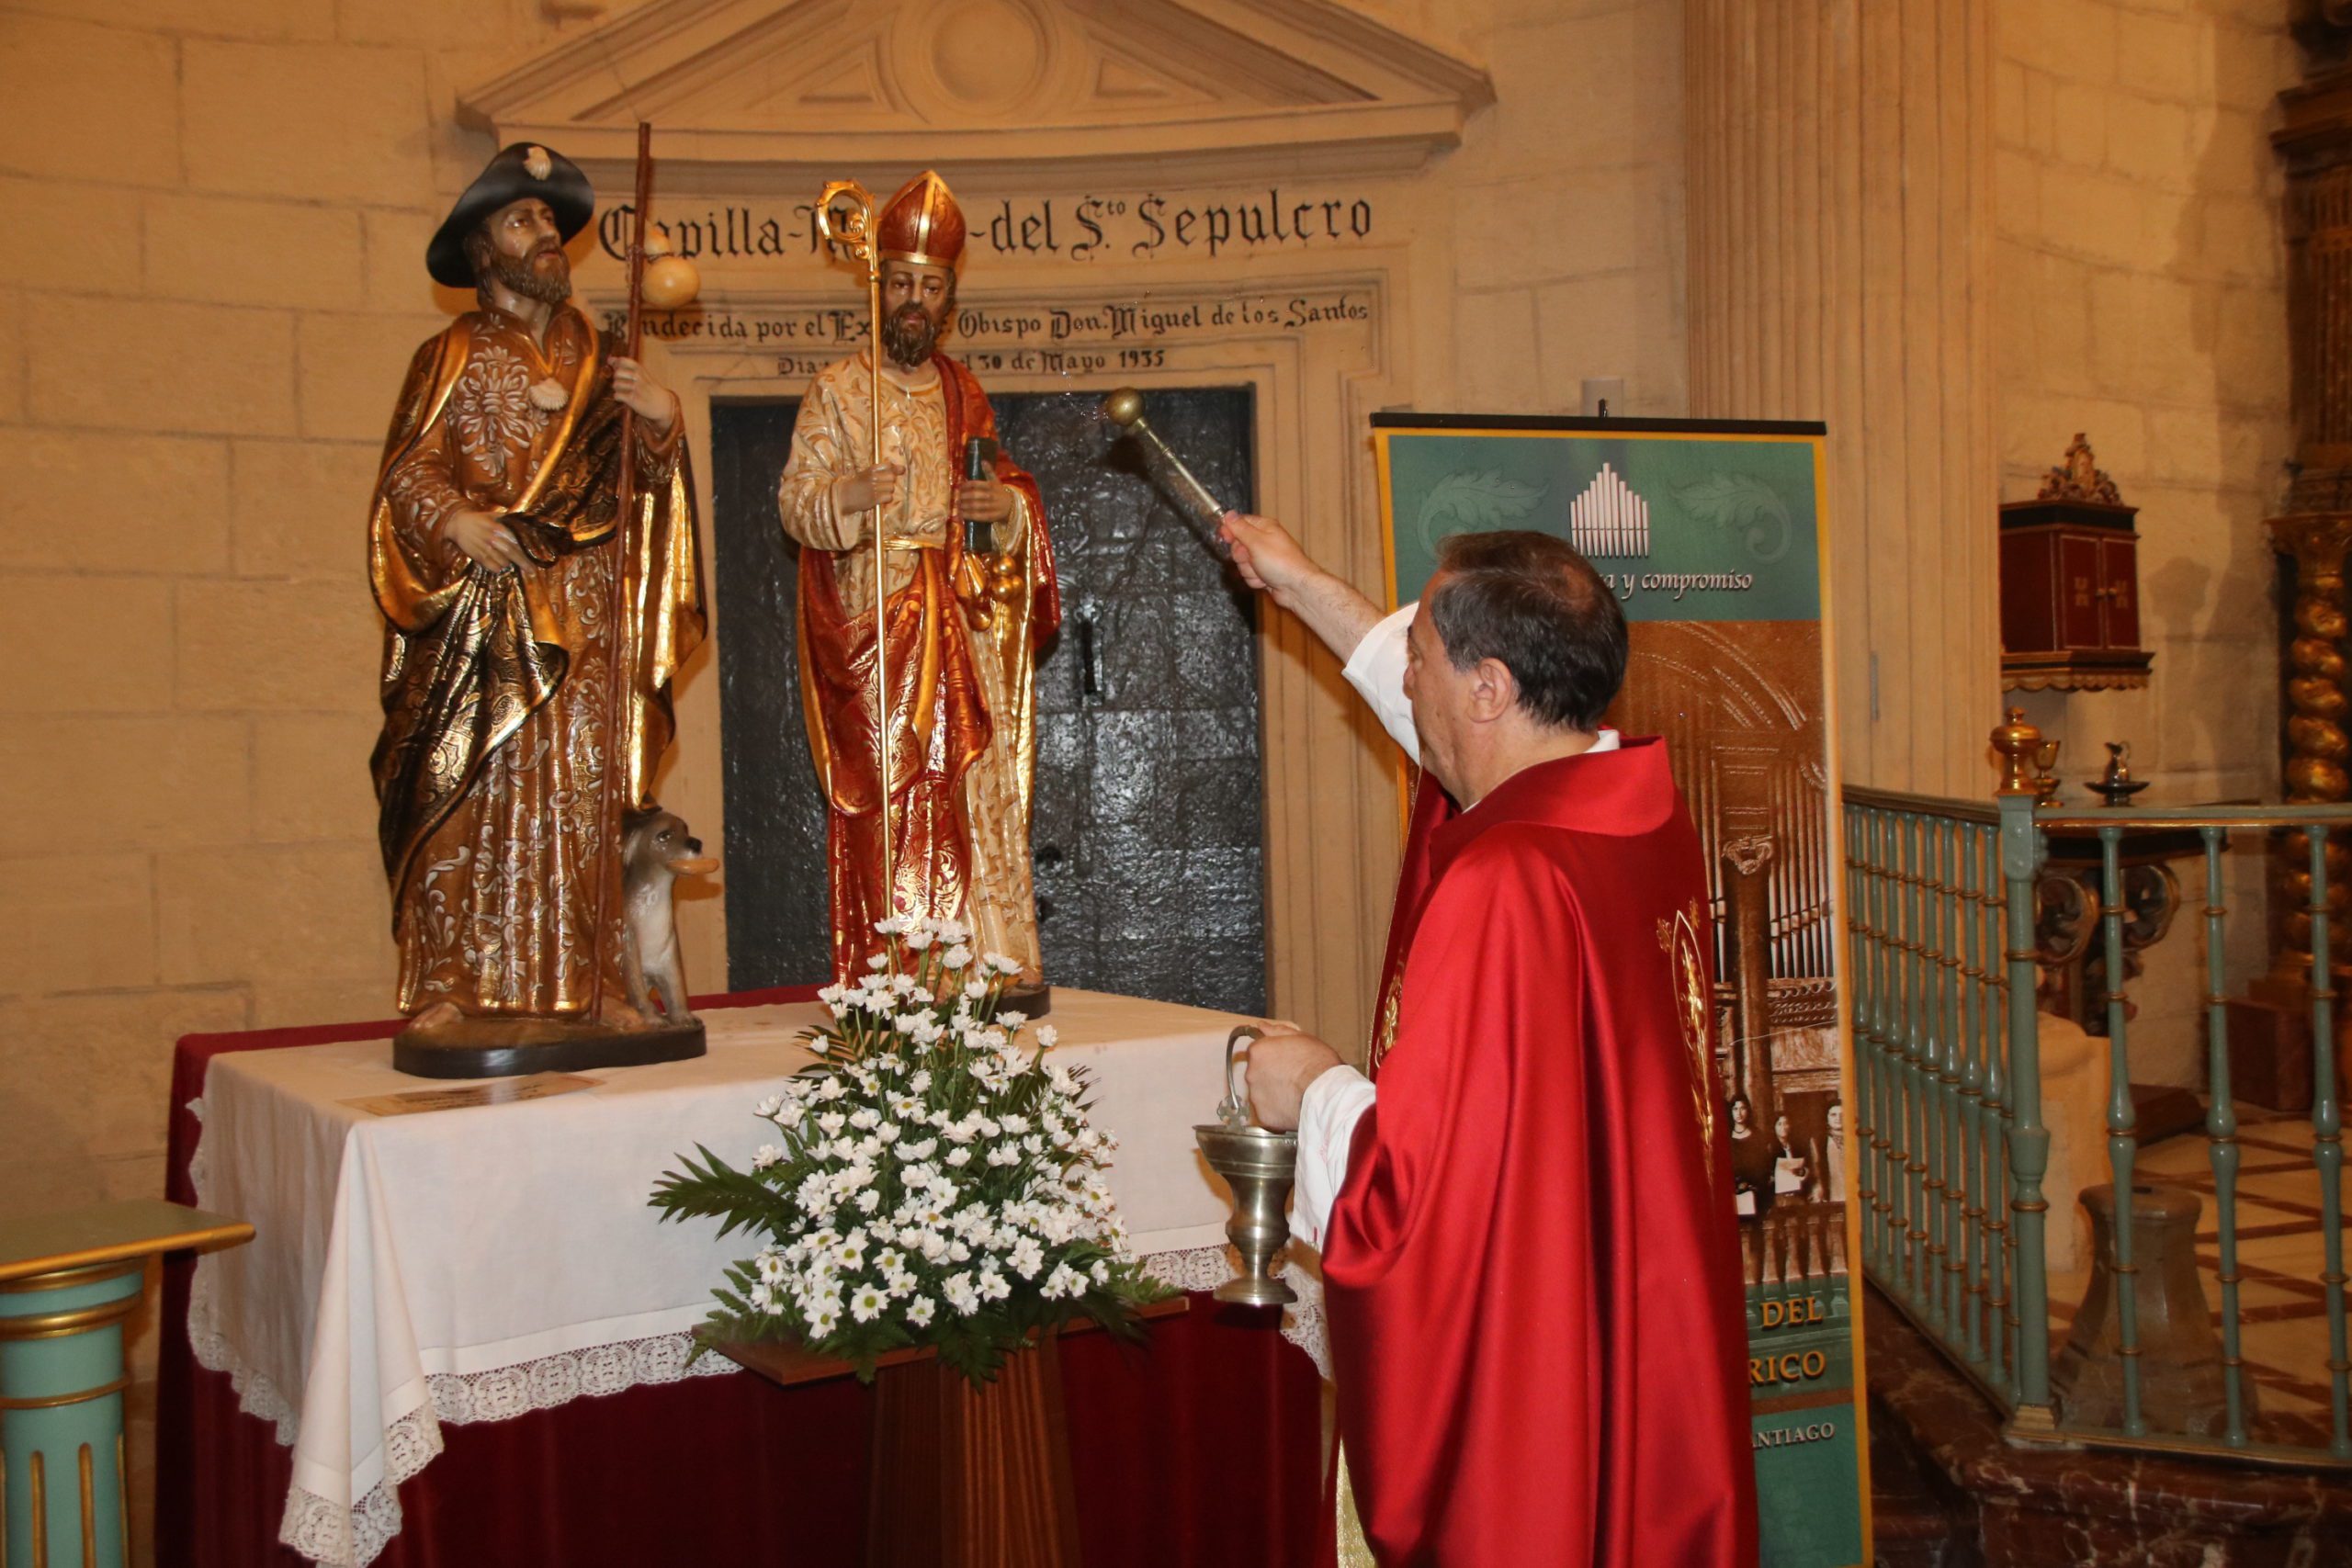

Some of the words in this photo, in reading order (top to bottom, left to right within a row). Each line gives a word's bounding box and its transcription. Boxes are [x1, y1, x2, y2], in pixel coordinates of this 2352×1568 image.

[1132, 189, 1373, 262] Sepulcro
[603, 310, 747, 342] Bndecida
[756, 319, 797, 343] por
[805, 314, 826, 337] el
[958, 310, 1042, 339] Obispo
[1211, 304, 1235, 326] de
[1242, 301, 1279, 323] los
[1283, 295, 1368, 329] Santos
[1012, 354, 1035, 370] de
[1038, 350, 1106, 373] Mayo
[1119, 349, 1165, 368] 1935
[1621, 572, 1636, 600] y
[1641, 568, 1753, 600] compromiso
[1761, 1296, 1823, 1329] DEL
[1749, 1350, 1826, 1383] RICO
